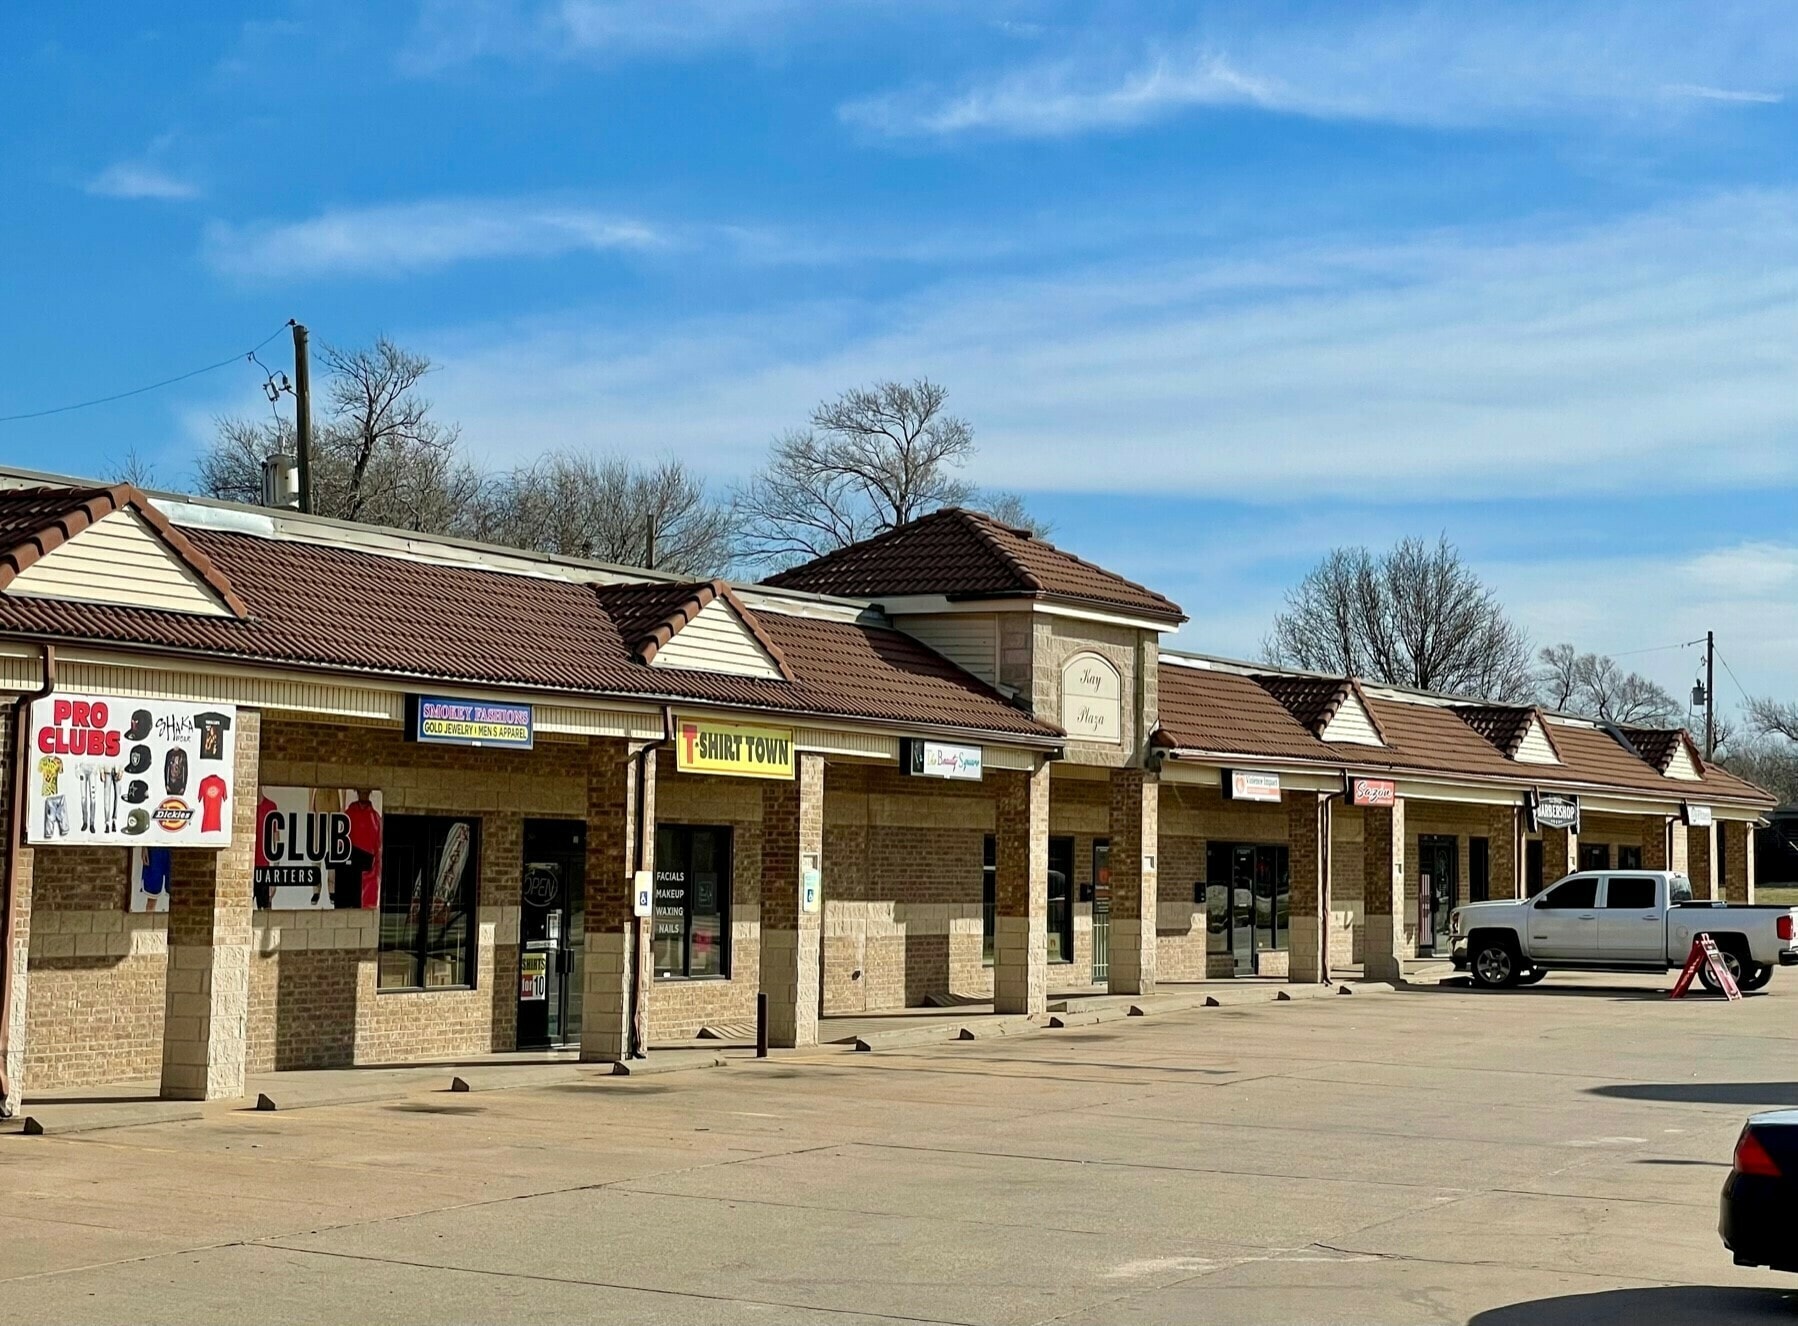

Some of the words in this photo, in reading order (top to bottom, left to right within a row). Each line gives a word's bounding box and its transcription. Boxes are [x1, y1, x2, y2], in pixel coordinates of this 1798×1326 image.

[1080, 667, 1102, 693] Kay
[54, 699, 109, 729] PRO
[423, 703, 473, 721] SMOKEY
[474, 706, 529, 725] FASHIONS
[1077, 705, 1105, 732] Plaza
[155, 713, 194, 741] SHAKA
[424, 721, 443, 734] GOLD
[444, 723, 473, 736] JEWELRY
[478, 725, 498, 737] MENS
[499, 727, 527, 739] APPAREL
[38, 726, 121, 757] CLUBS
[682, 724, 743, 765] T-SHIRT
[745, 735, 789, 765] TOWN
[155, 810, 191, 819] Dickies
[263, 810, 352, 862] CLUB
[255, 869, 314, 883] UARTERS
[524, 876, 555, 897] OPEN
[656, 871, 685, 882] FACIALS
[656, 889, 685, 899] MAKEUP
[656, 906, 684, 916] WAXING
[658, 924, 680, 934] NAILS
[521, 957, 546, 971] SHIRTS
[534, 975, 545, 996] 10
